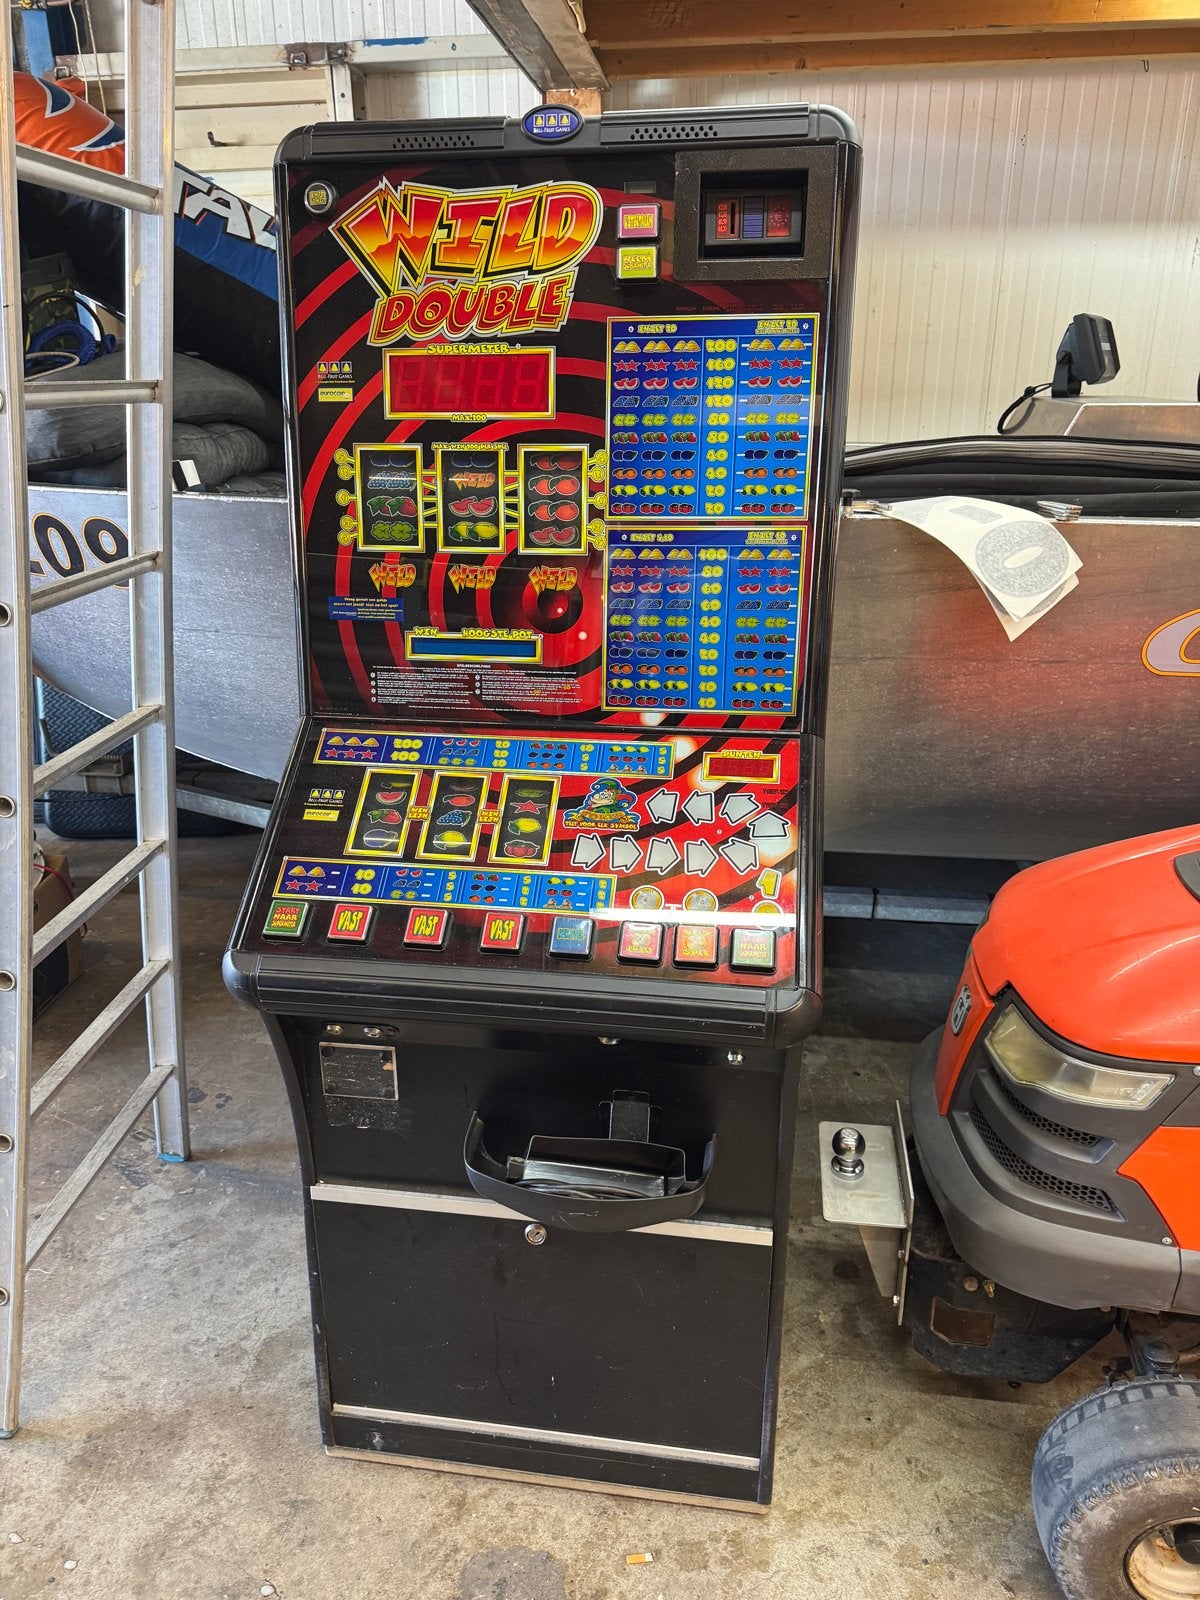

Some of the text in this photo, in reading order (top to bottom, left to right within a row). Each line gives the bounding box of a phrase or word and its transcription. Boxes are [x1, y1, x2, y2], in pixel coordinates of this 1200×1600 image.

[335, 180, 602, 297] WILD
[371, 270, 577, 343] DOUBLE
[427, 344, 509, 354] SUPERMETER
[706, 338, 737, 352] 200
[706, 375, 735, 389] 120
[705, 393, 734, 408] 120
[707, 412, 730, 426] 80
[706, 430, 730, 444] 80
[453, 471, 497, 491] WILD
[698, 548, 728, 561] 100
[368, 562, 416, 593] WILD
[448, 563, 496, 594] WILD
[529, 565, 578, 595] WILD
[414, 627, 535, 639] WIN HOOGSTE POT
[393, 738, 423, 749] 200
[390, 750, 420, 762] 100
[722, 750, 762, 759] PUNTEN
[337, 910, 364, 931] VAST
[413, 914, 440, 936] VAST
[489, 918, 515, 941] VAST
[740, 943, 767, 951] NAAR
